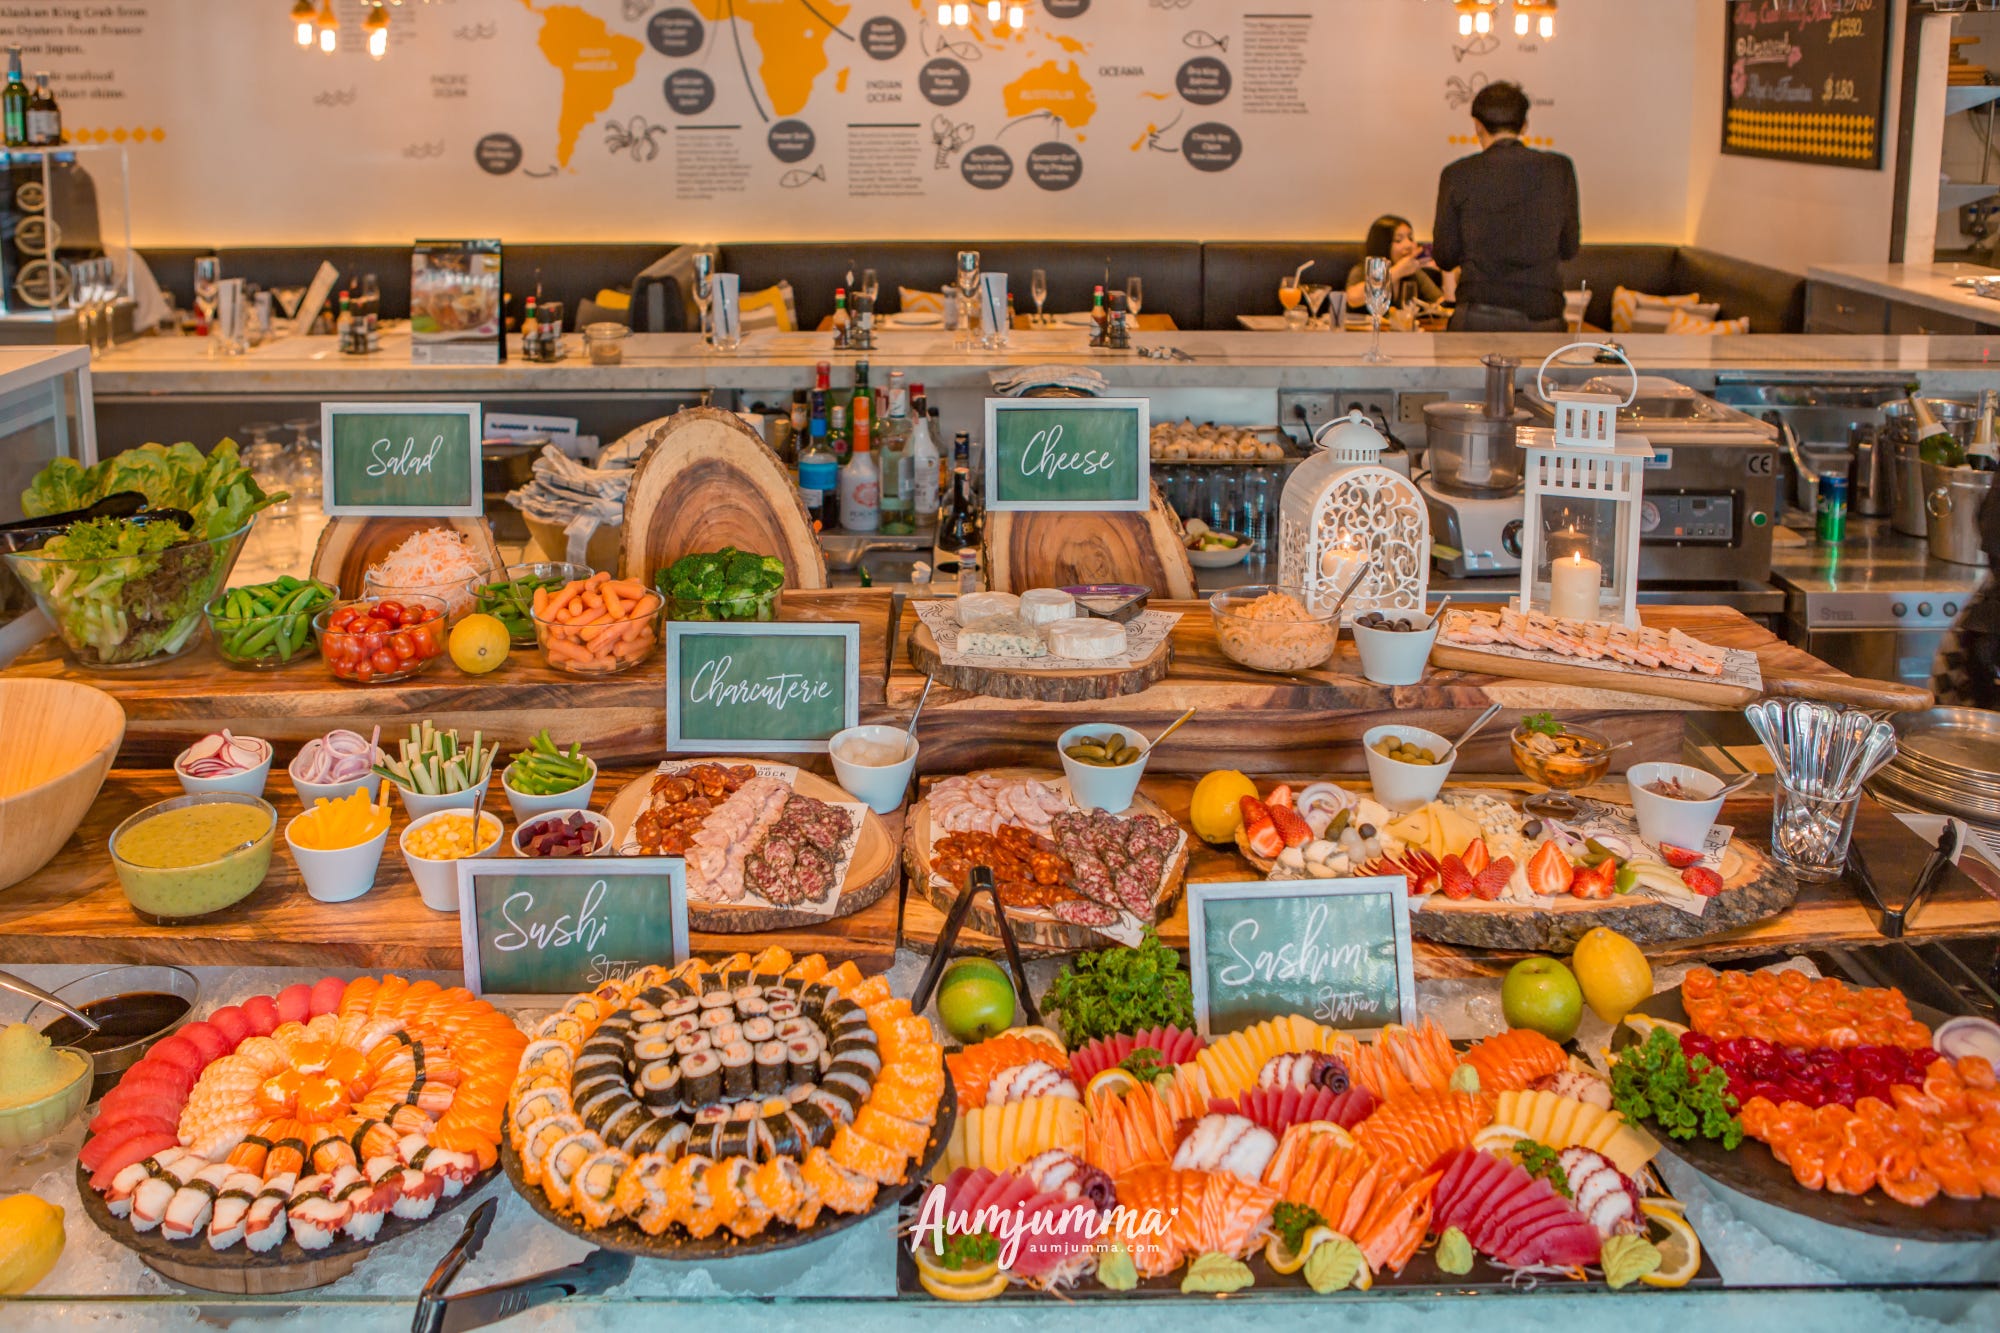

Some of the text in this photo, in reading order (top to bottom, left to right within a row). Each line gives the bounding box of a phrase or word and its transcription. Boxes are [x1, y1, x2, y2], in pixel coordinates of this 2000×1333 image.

[1099, 66, 1145, 76] OCEANIA
[866, 93, 903, 103] OCEAN
[366, 434, 444, 477] Salad
[1020, 424, 1116, 480] Cheese
[1749, 455, 1772, 474] CE
[690, 655, 833, 710] Charcuterie
[494, 879, 609, 953] Sushi
[1220, 903, 1371, 987] Sashimi
[1313, 985, 1380, 1022] Station
